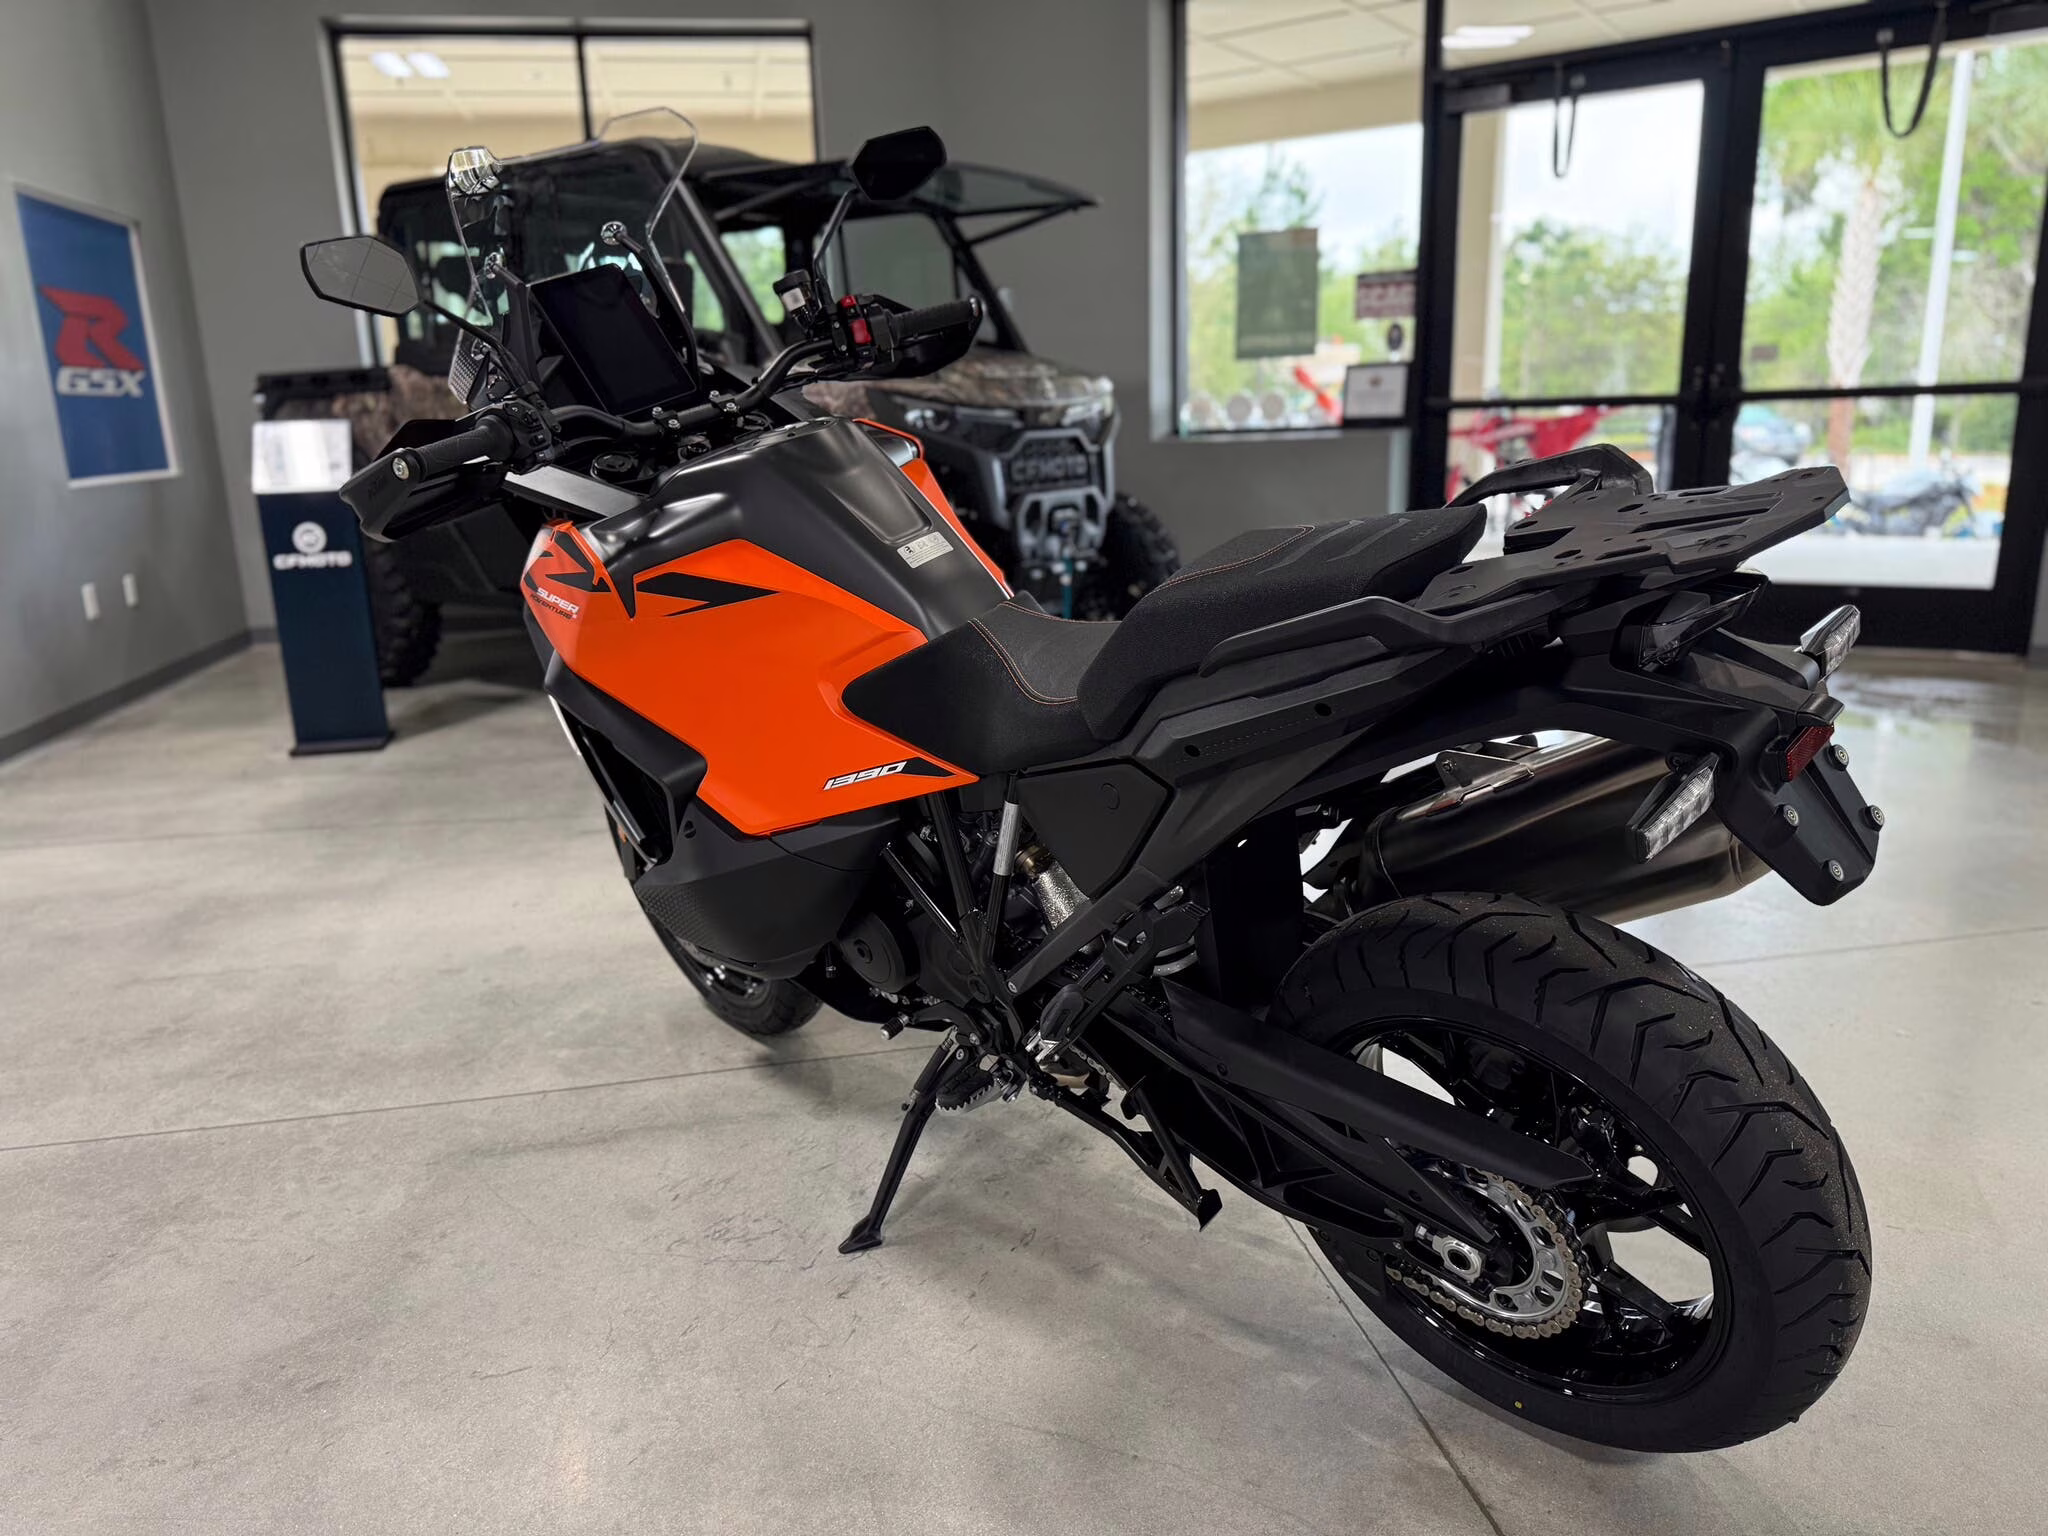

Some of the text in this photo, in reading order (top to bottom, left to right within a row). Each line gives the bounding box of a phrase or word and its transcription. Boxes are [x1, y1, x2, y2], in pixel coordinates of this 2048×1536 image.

[40, 286, 144, 368] R
[57, 367, 145, 397] GSX
[537, 587, 579, 613] SUPER
[823, 761, 908, 791] 1390
